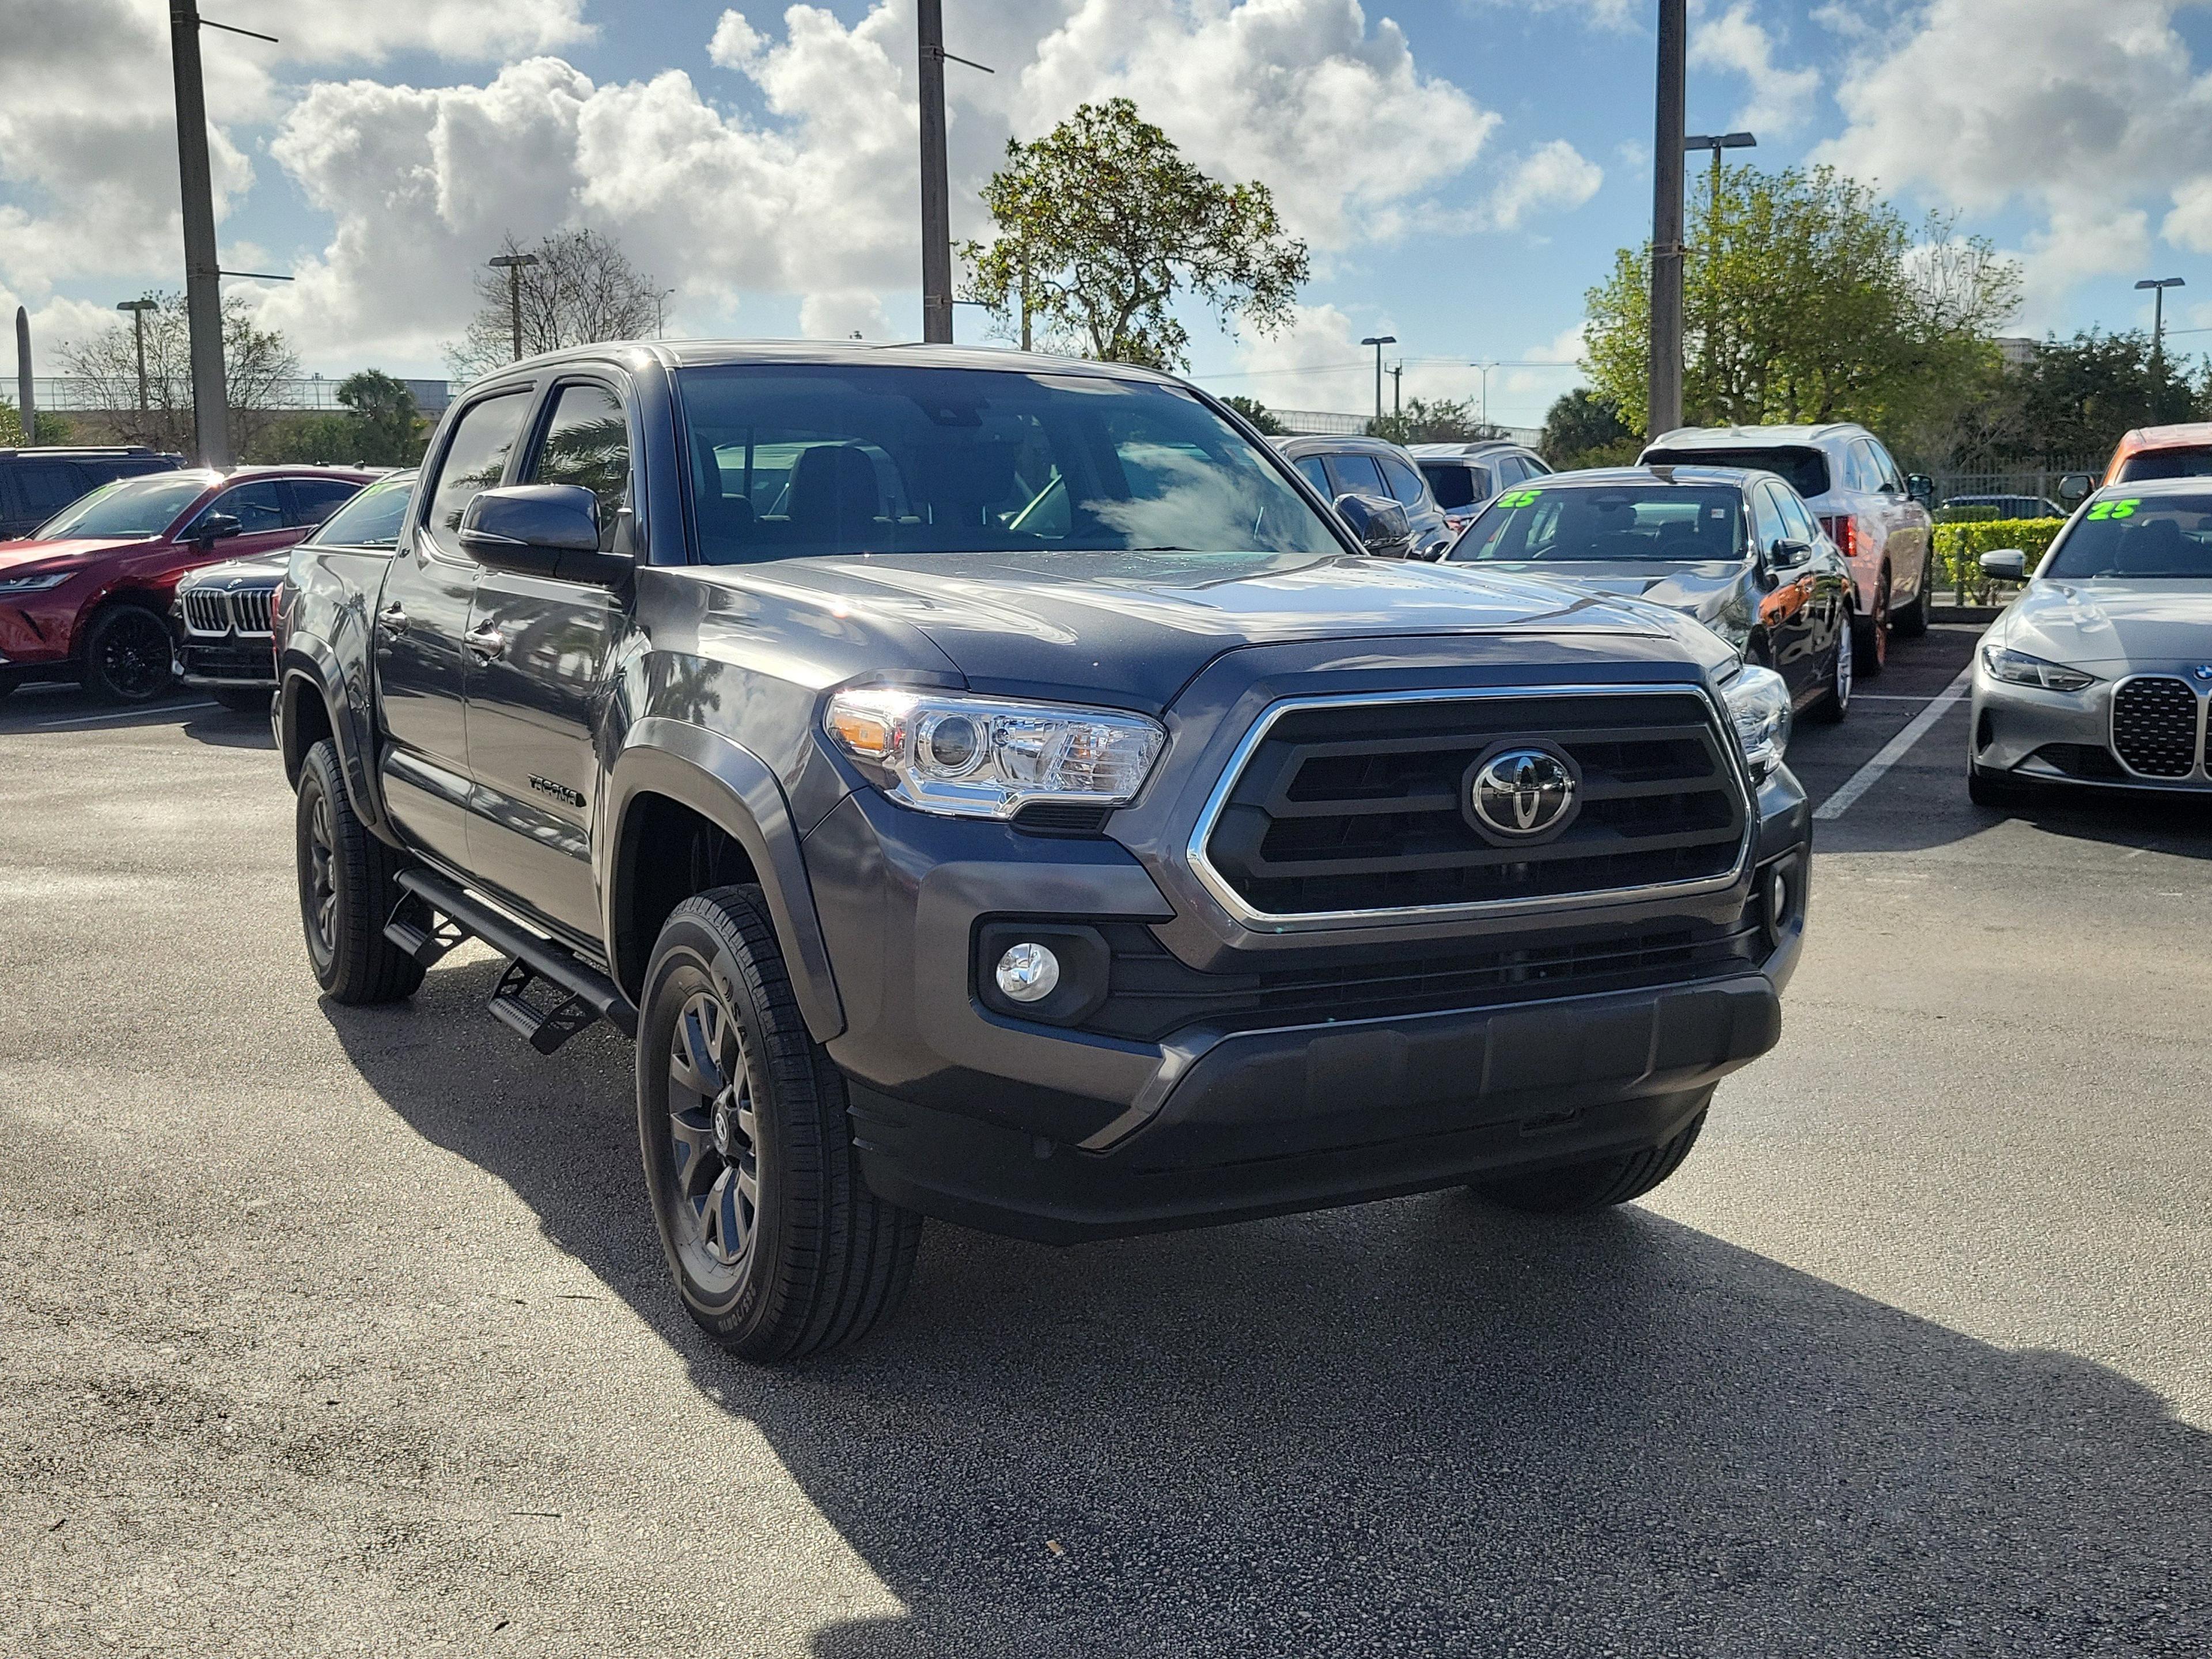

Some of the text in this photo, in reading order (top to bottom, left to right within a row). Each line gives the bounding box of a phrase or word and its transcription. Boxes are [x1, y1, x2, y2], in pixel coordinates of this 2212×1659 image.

[1497, 490, 1542, 508] 25
[2086, 498, 2141, 520] 25
[525, 772, 586, 807] TACOMA
